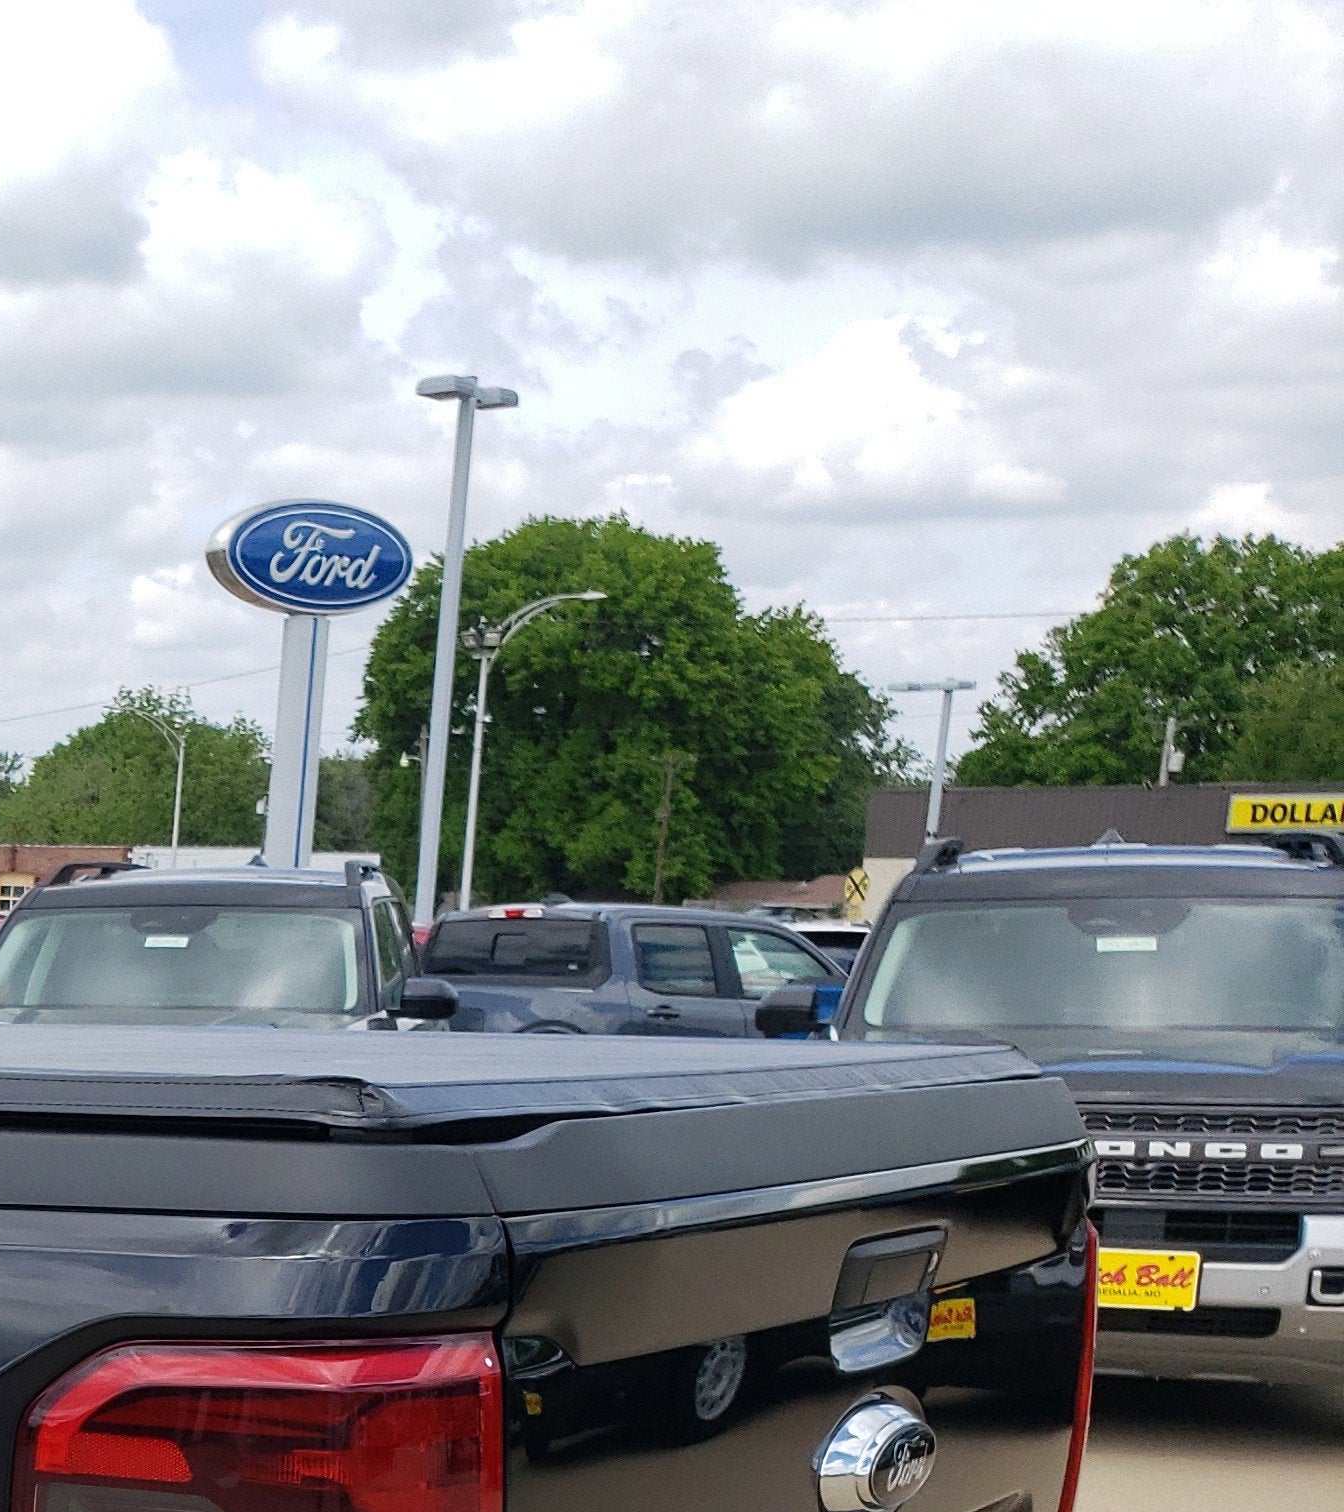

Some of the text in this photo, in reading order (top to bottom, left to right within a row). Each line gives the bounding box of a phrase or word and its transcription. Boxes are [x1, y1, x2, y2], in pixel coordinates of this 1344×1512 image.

[269, 520, 381, 589] Ford
[1249, 803, 1344, 824] DOLLA
[1095, 1140, 1303, 1159] ONCO
[886, 1433, 930, 1492] Ford
